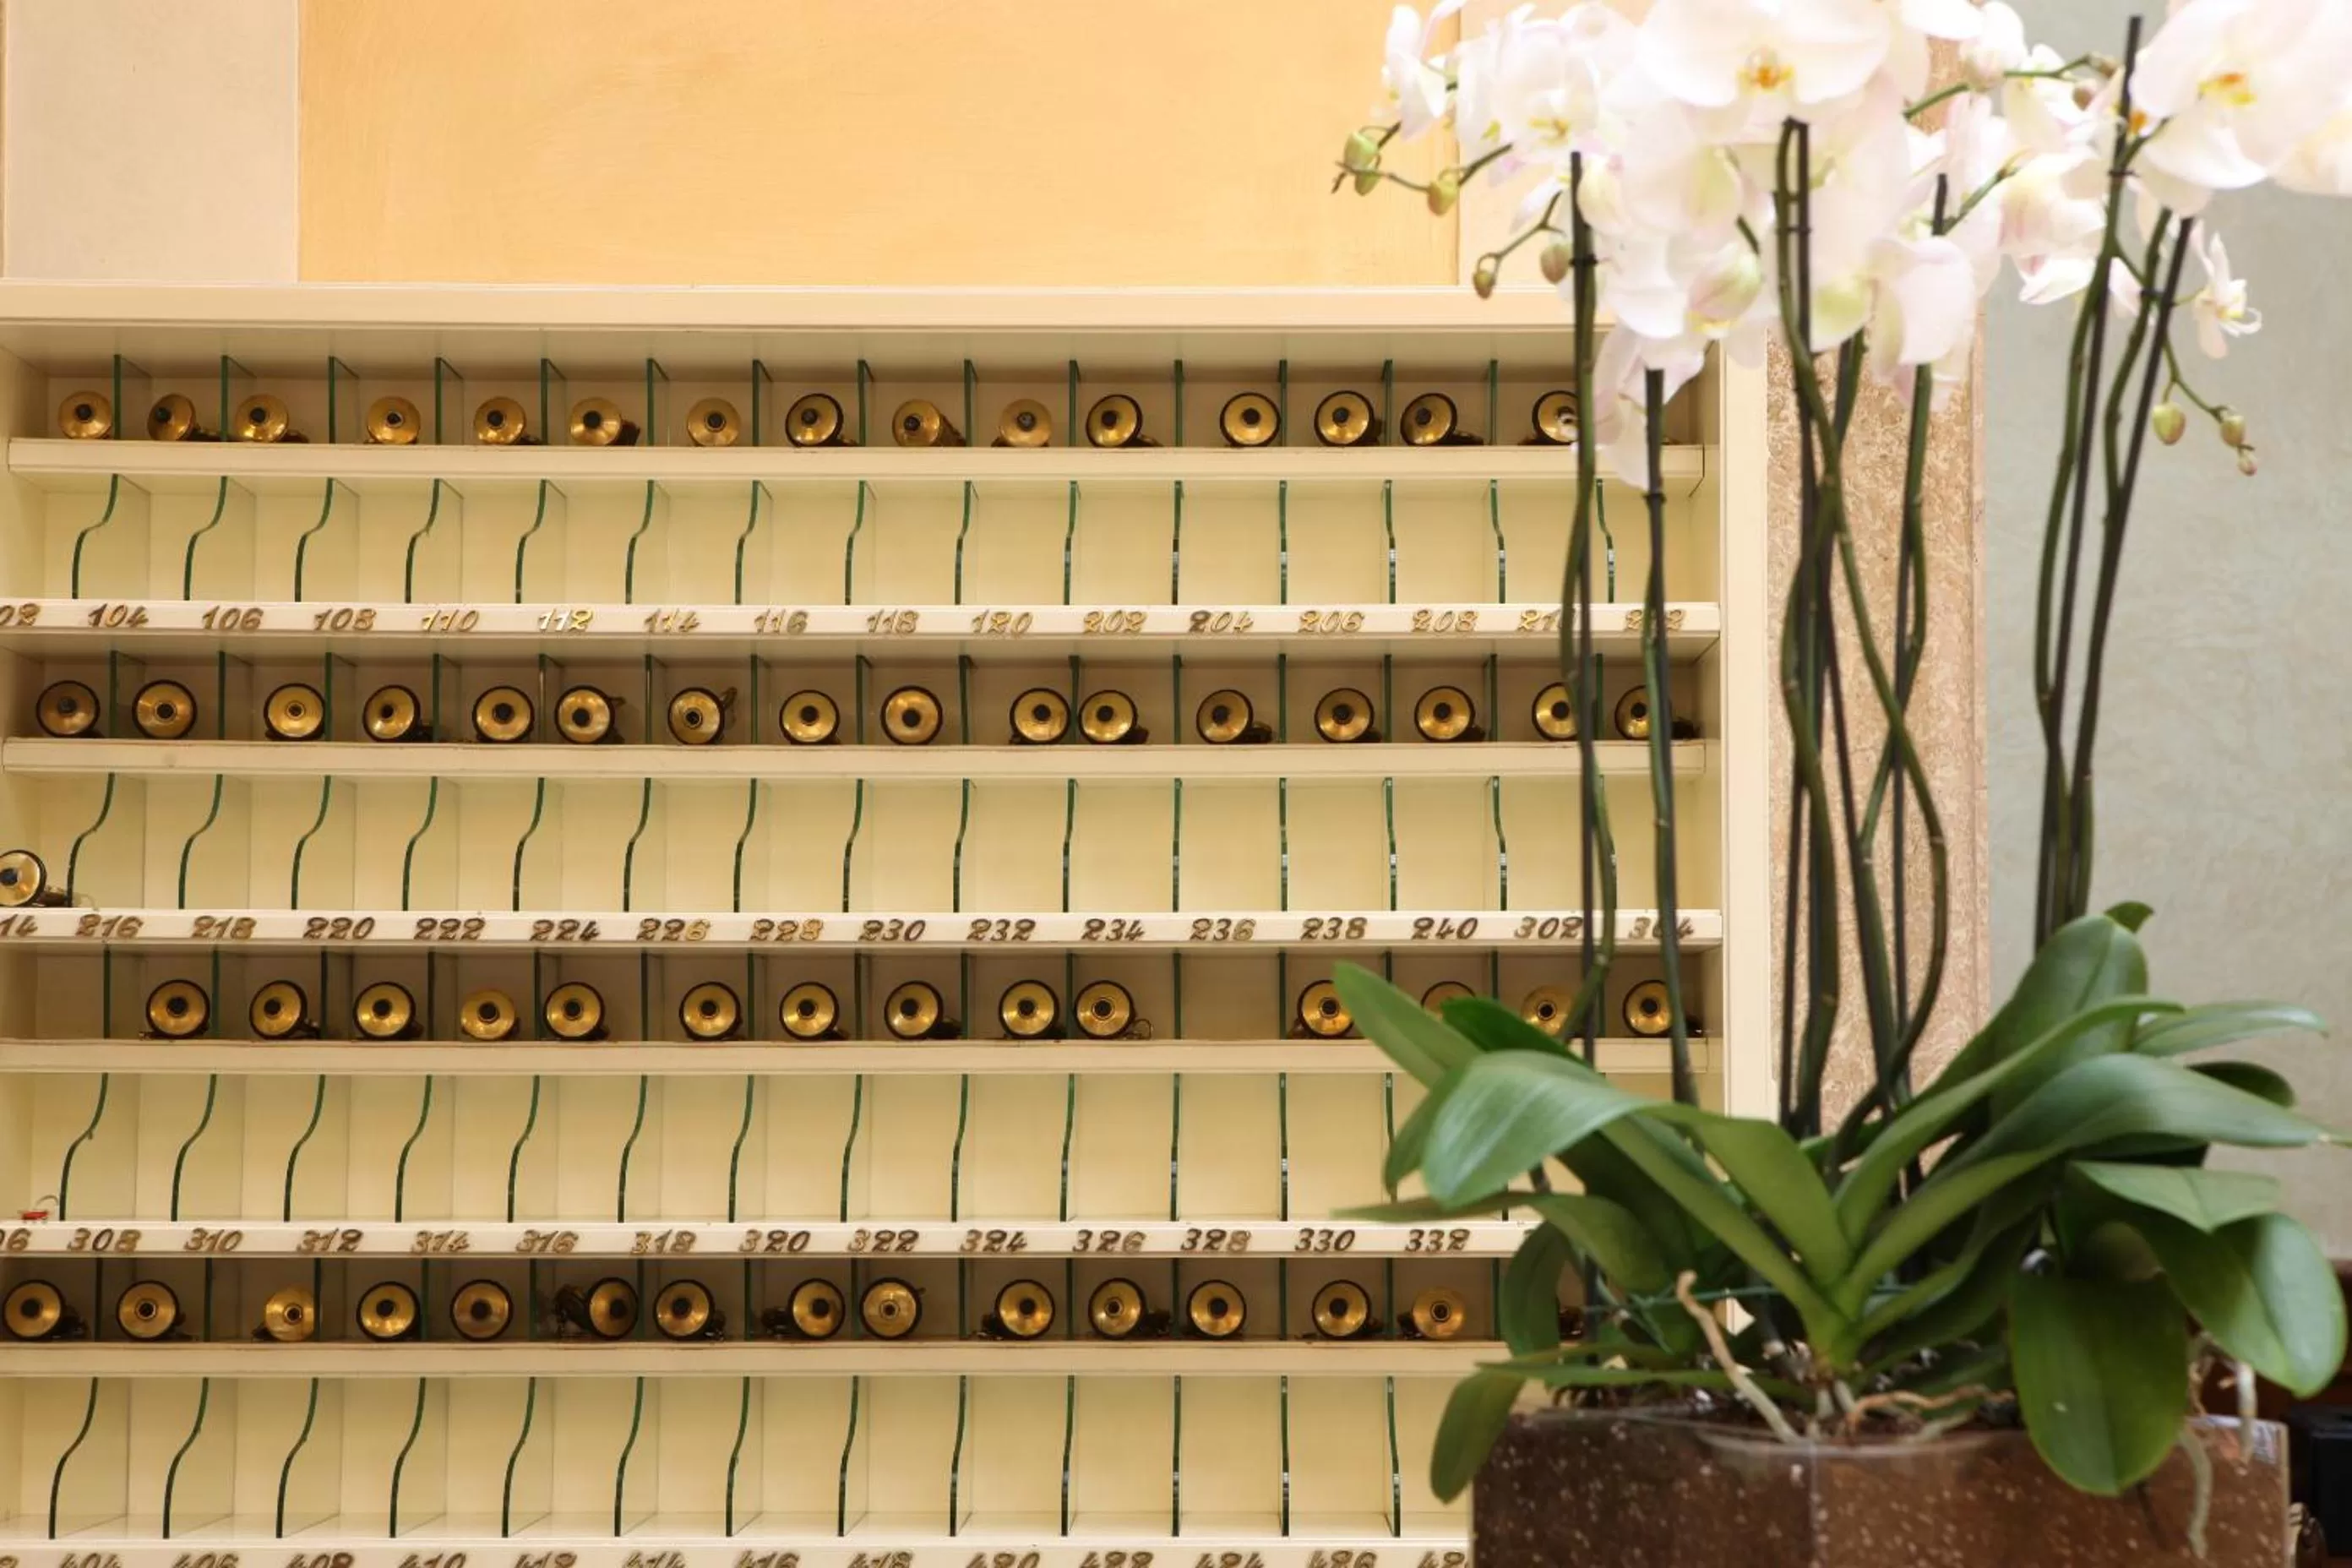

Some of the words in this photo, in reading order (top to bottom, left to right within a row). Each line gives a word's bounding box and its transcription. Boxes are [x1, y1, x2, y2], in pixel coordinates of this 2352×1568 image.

[88, 603, 150, 628] 104
[201, 607, 263, 631] 106
[313, 608, 377, 632] 108
[422, 609, 478, 632] 110
[538, 608, 593, 633] 112
[644, 608, 701, 633] 114
[754, 608, 808, 634] 116
[866, 607, 919, 634] 118
[972, 608, 1033, 634] 120
[1083, 608, 1147, 634] 202
[1189, 610, 1254, 634] 204
[1298, 609, 1365, 634] 206
[1412, 608, 1478, 634] 208
[1517, 609, 1576, 632] 21
[1624, 609, 1685, 632] 22
[75, 913, 144, 939] 216
[192, 916, 257, 939] 218
[302, 917, 375, 940] 220
[413, 917, 485, 940] 222
[529, 919, 602, 941] 224
[636, 918, 710, 941] 226
[750, 918, 824, 941] 228
[858, 919, 926, 942] 230
[966, 918, 1037, 942] 232
[1081, 919, 1144, 942] 234
[1190, 917, 1255, 941] 236
[1300, 917, 1368, 940] 238
[1411, 917, 1478, 940] 240
[1514, 917, 1583, 939] 302
[0, 1228, 32, 1251] 6
[67, 1228, 142, 1253] 308
[183, 1228, 243, 1252] 310
[296, 1228, 363, 1253] 312
[411, 1230, 471, 1254] 314
[516, 1230, 579, 1254] 316
[629, 1231, 697, 1255] 318
[738, 1230, 811, 1254] 320
[847, 1229, 919, 1254] 322
[960, 1231, 1027, 1254] 324
[1072, 1231, 1146, 1254] 326
[1180, 1228, 1252, 1253] 328
[1294, 1228, 1356, 1252] 330
[1405, 1228, 1470, 1252] 332
